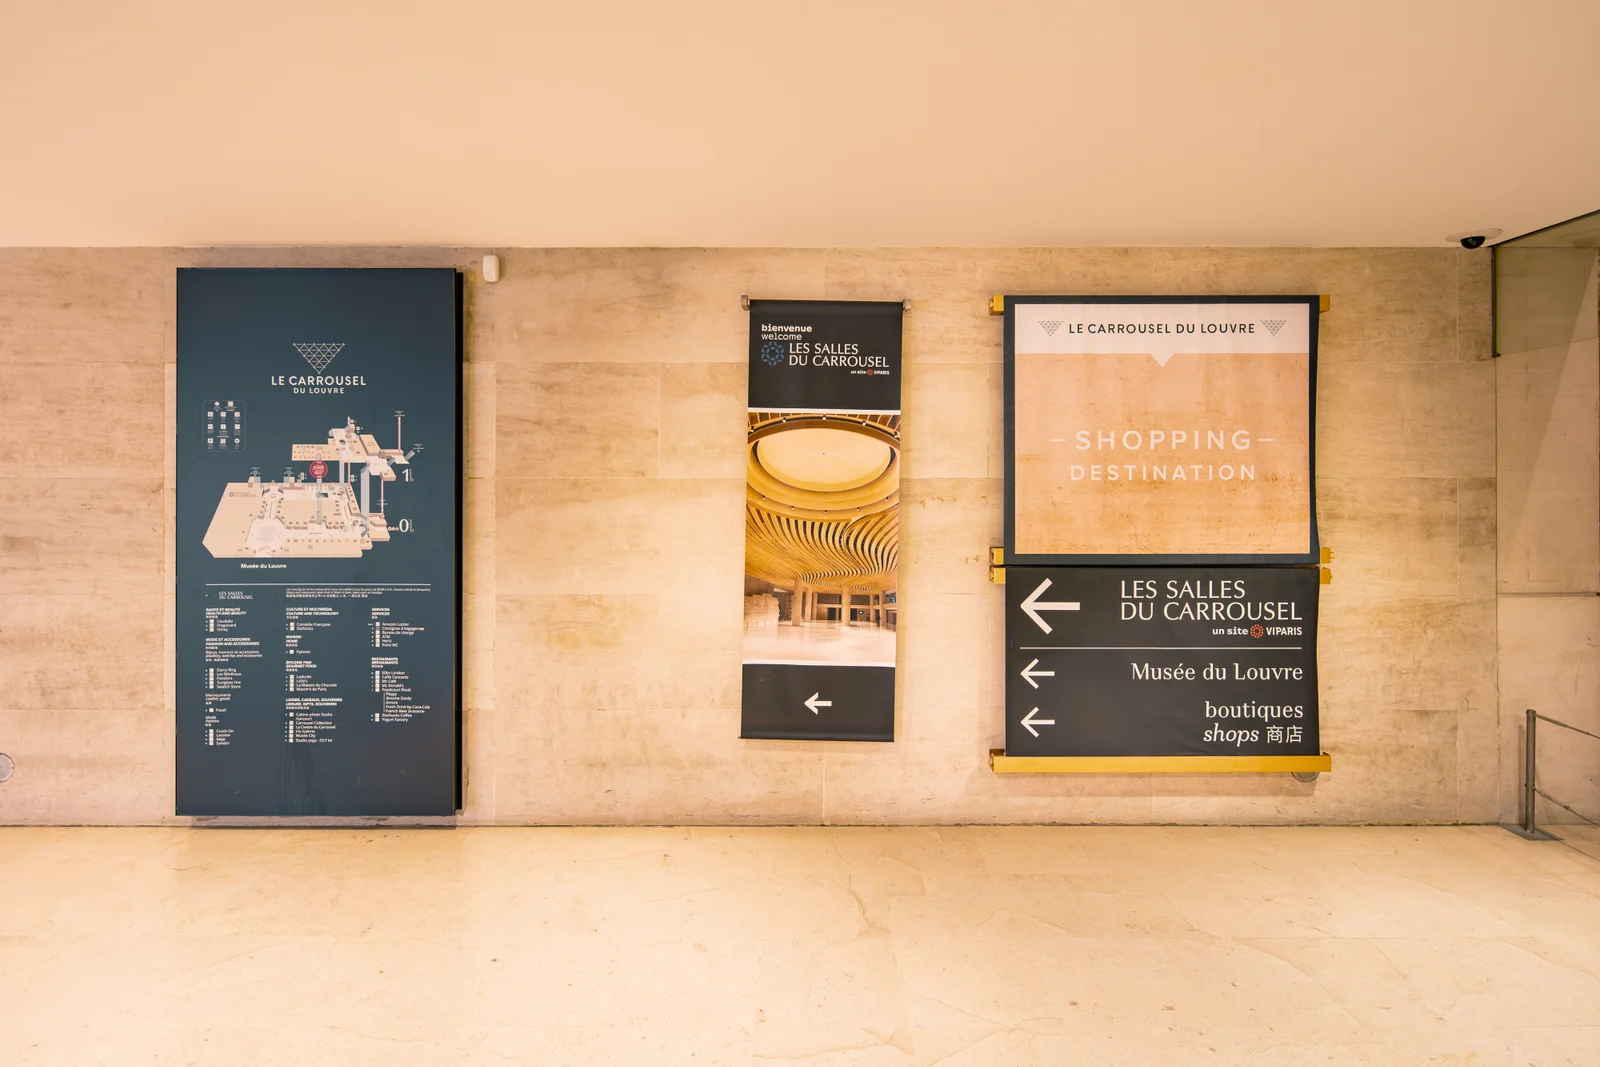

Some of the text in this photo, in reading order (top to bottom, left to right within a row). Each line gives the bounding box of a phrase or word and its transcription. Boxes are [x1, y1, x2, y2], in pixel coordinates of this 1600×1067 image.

[761, 324, 812, 333] bienvenue
[1069, 323, 1255, 334] LE CARROUSEL DU LOUVRE
[761, 333, 802, 341] welcome
[789, 343, 858, 355] LES SALLES
[789, 355, 889, 368] DU CARROUSEL
[271, 376, 366, 385] LE CARROUSEL
[1076, 430, 1251, 450] SHOPPING
[402, 469, 409, 482] 1
[1070, 465, 1255, 481] DESTINATION
[399, 519, 409, 532] 0
[1121, 580, 1245, 599] LES SALLES
[1121, 602, 1302, 621] DU CARROUSEL
[1227, 627, 1248, 636] site
[1266, 627, 1302, 636] VIPARIS
[1131, 663, 1303, 681] Musée du Louvre
[1205, 701, 1303, 722] boutiques
[1203, 724, 1303, 747] shops 商店
